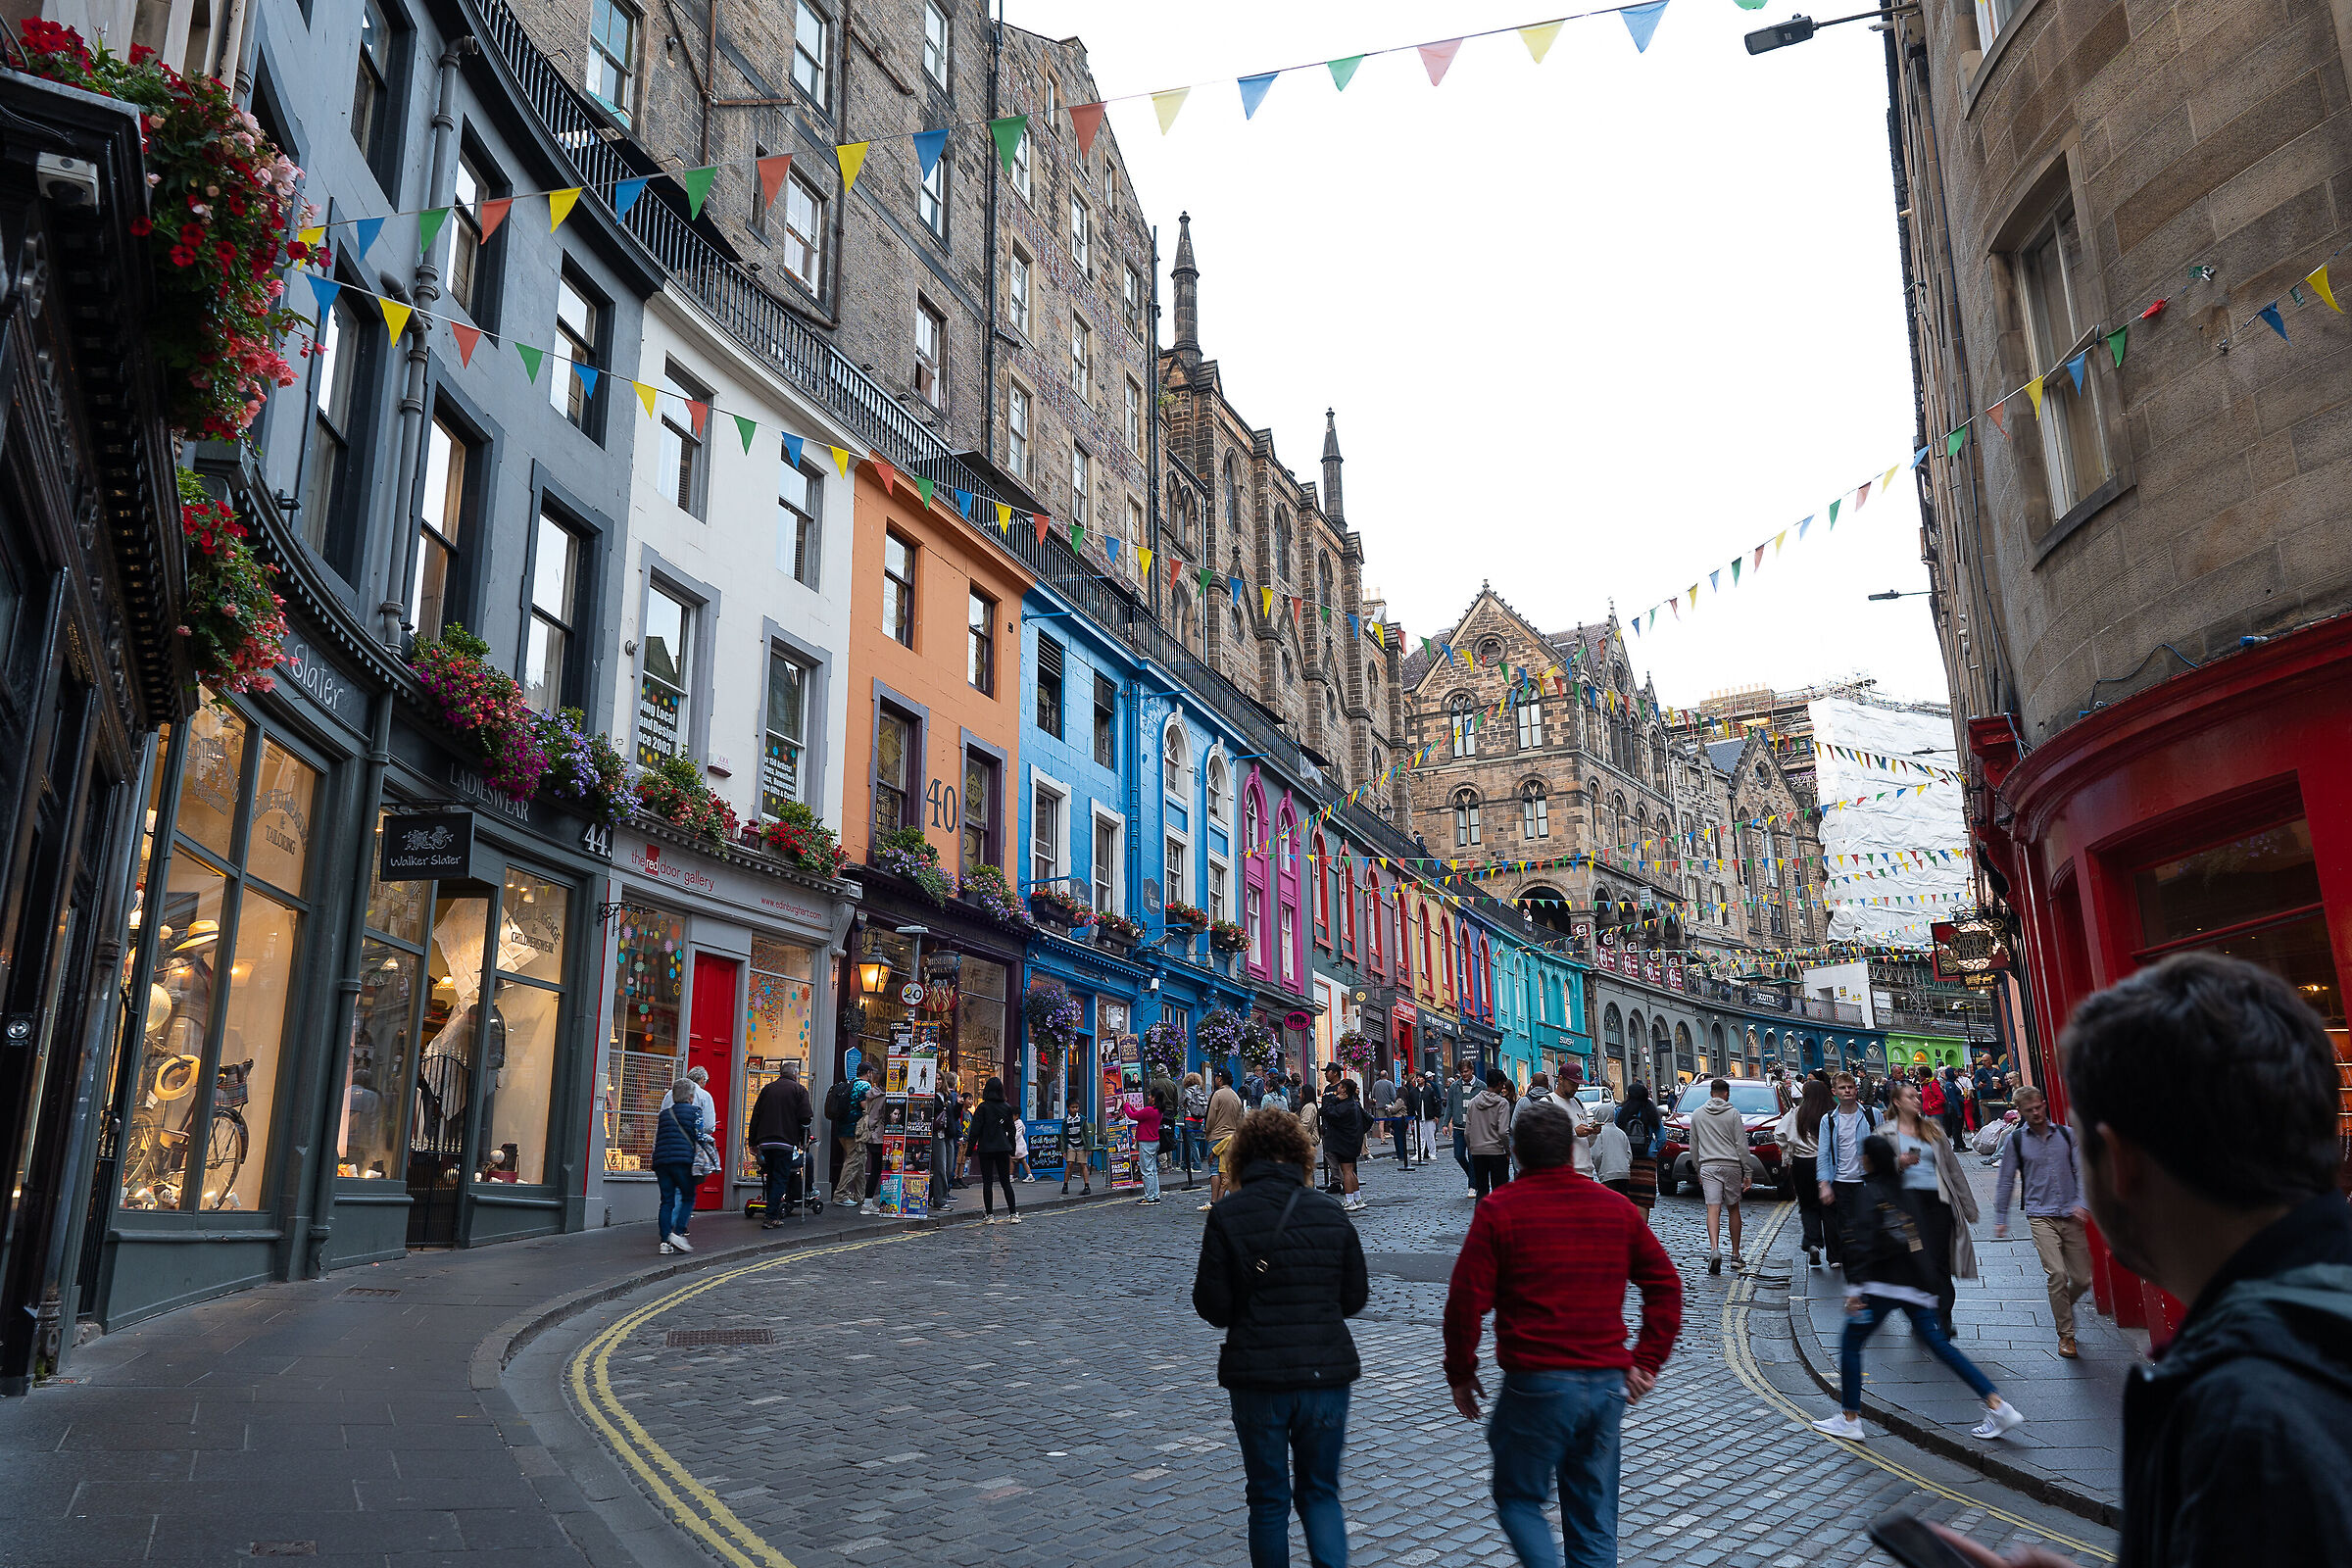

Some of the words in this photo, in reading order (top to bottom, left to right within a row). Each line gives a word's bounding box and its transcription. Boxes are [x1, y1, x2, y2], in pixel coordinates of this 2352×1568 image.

[291, 643, 345, 710] Slater
[657, 705, 676, 725] Local
[639, 715, 653, 731] and
[653, 719, 677, 742] Design
[652, 736, 671, 757] 2003
[449, 762, 530, 821] LADIESWEAR
[926, 778, 956, 833] 40
[266, 824, 296, 855] TAILORING
[390, 855, 429, 867] Walker
[430, 854, 462, 865] Slater
[631, 850, 646, 867] the
[646, 852, 660, 871] red
[661, 861, 681, 878] door
[684, 870, 714, 892] gallery
[760, 896, 822, 920] www.edinburghart.com
[879, 971, 889, 985] 40
[903, 987, 922, 1001] 20
[1756, 992, 1775, 1004] SCOTTS
[1558, 1036, 1575, 1046] SWISH
